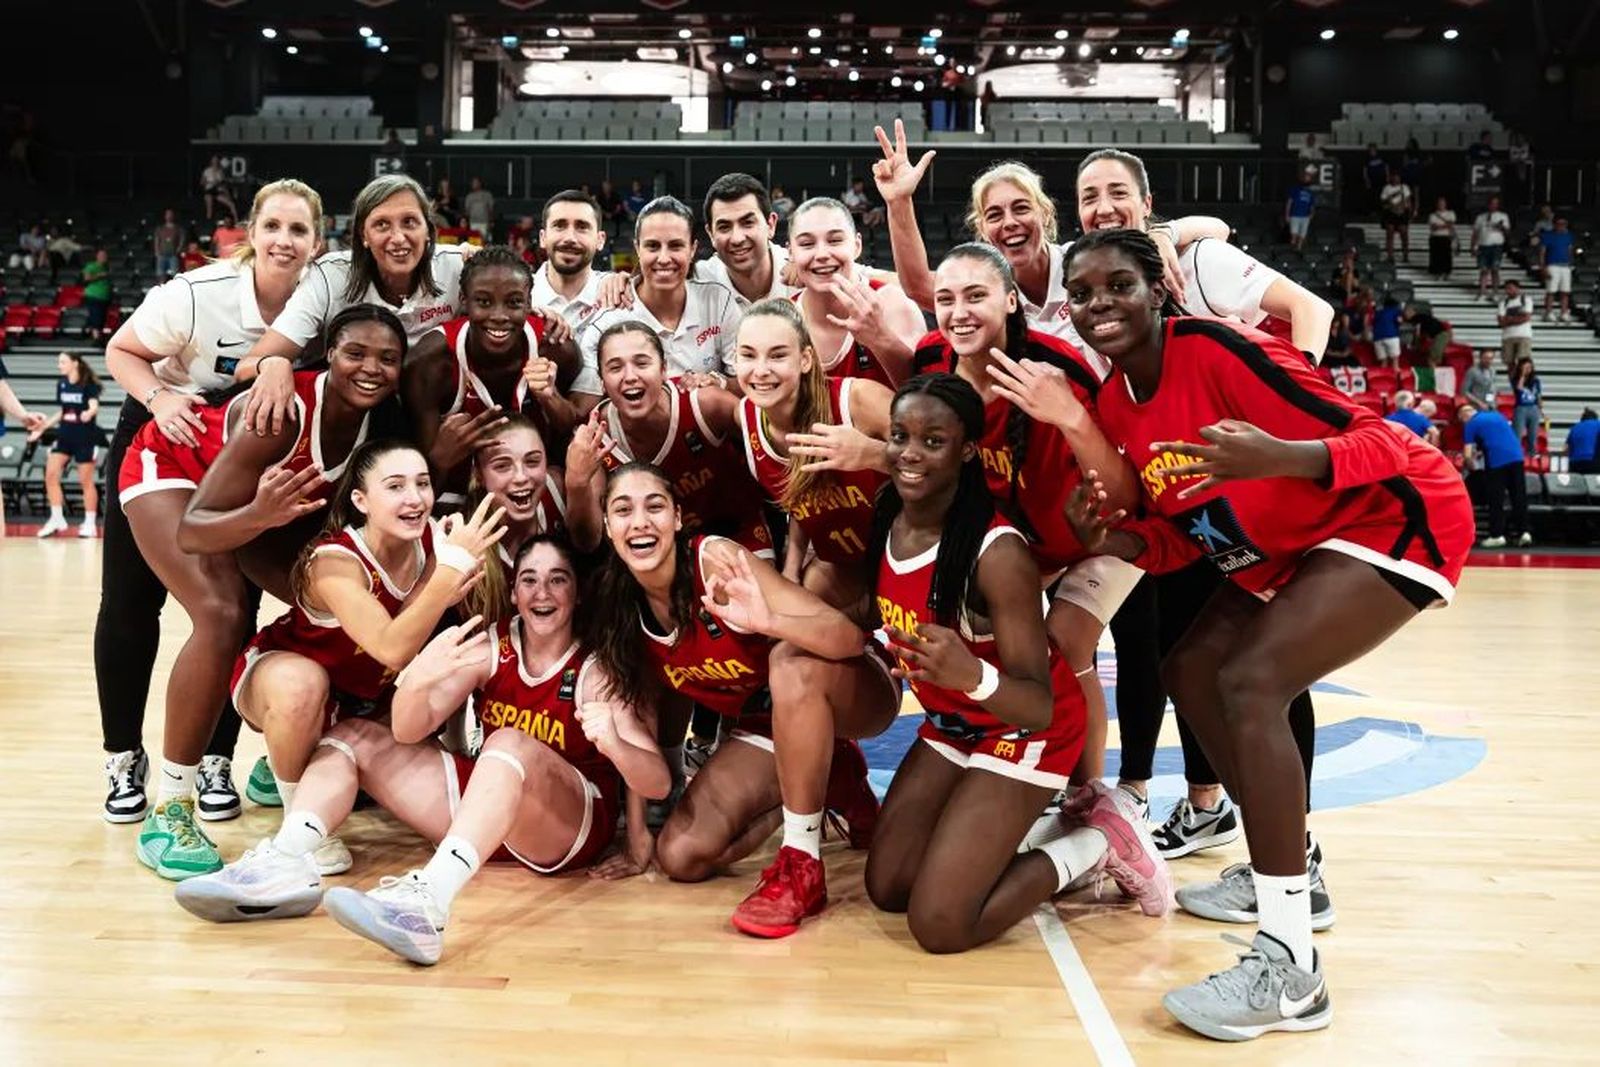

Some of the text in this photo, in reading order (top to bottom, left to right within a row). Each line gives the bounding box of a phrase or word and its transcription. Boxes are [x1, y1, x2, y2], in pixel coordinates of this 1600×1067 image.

[1319, 164, 1334, 184] E
[1471, 164, 1486, 185] F
[829, 526, 867, 555] 11
